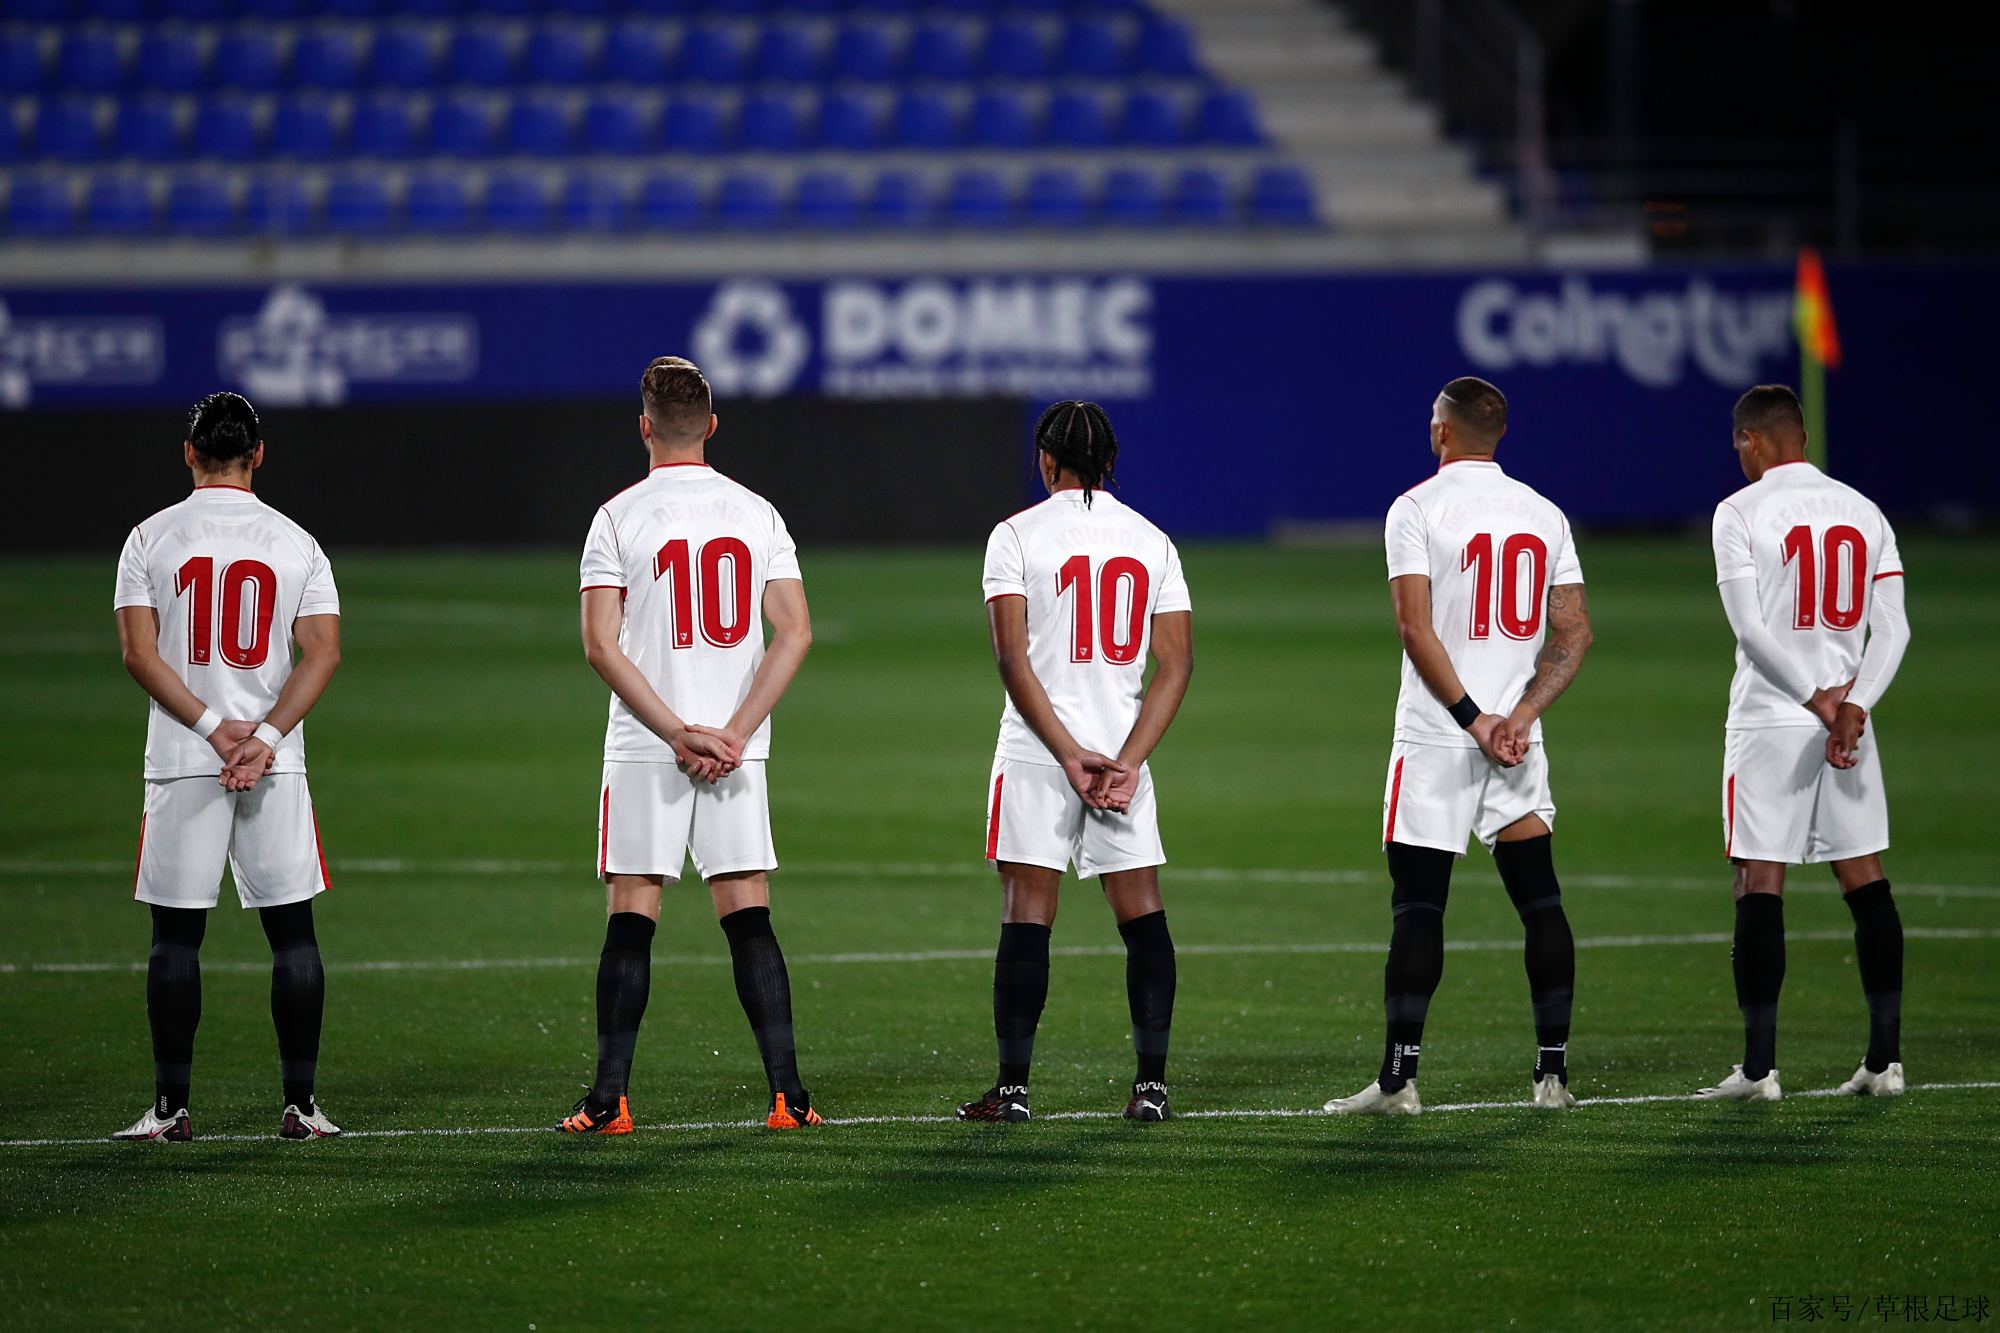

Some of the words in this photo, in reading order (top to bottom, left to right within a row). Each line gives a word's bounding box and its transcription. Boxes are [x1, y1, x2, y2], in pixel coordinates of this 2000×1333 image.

[824, 279, 1153, 357] DOMEC
[175, 556, 276, 668] 10
[654, 536, 753, 648] 10
[1056, 554, 1150, 664] 10
[1462, 533, 1548, 641] 10
[1781, 525, 1868, 630] 10
